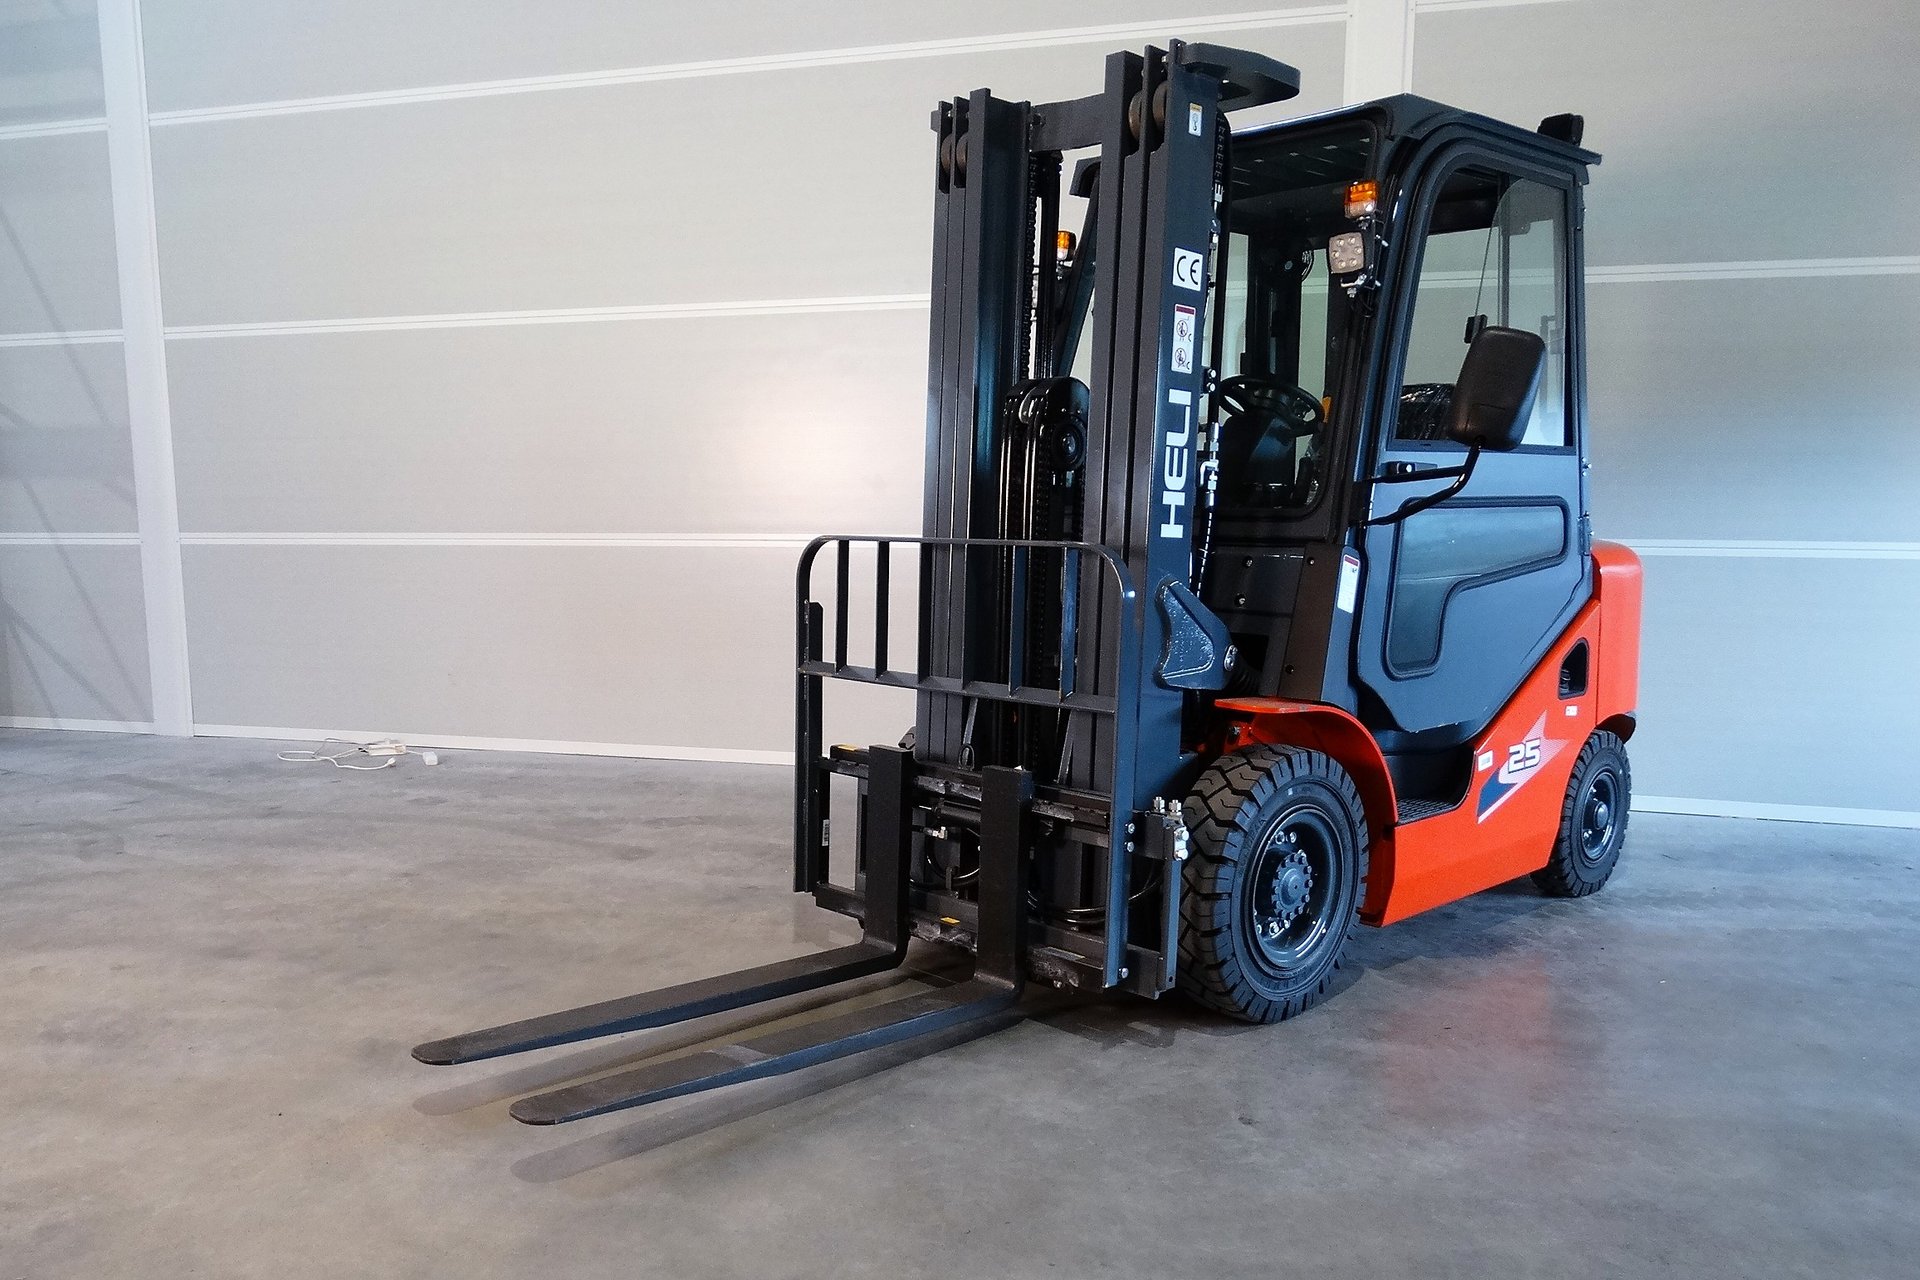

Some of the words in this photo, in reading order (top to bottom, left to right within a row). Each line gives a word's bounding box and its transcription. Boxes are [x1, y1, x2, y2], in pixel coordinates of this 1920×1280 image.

[1176, 255, 1200, 286] CE
[1160, 388, 1192, 539] HELI
[1507, 738, 1541, 774] 25
